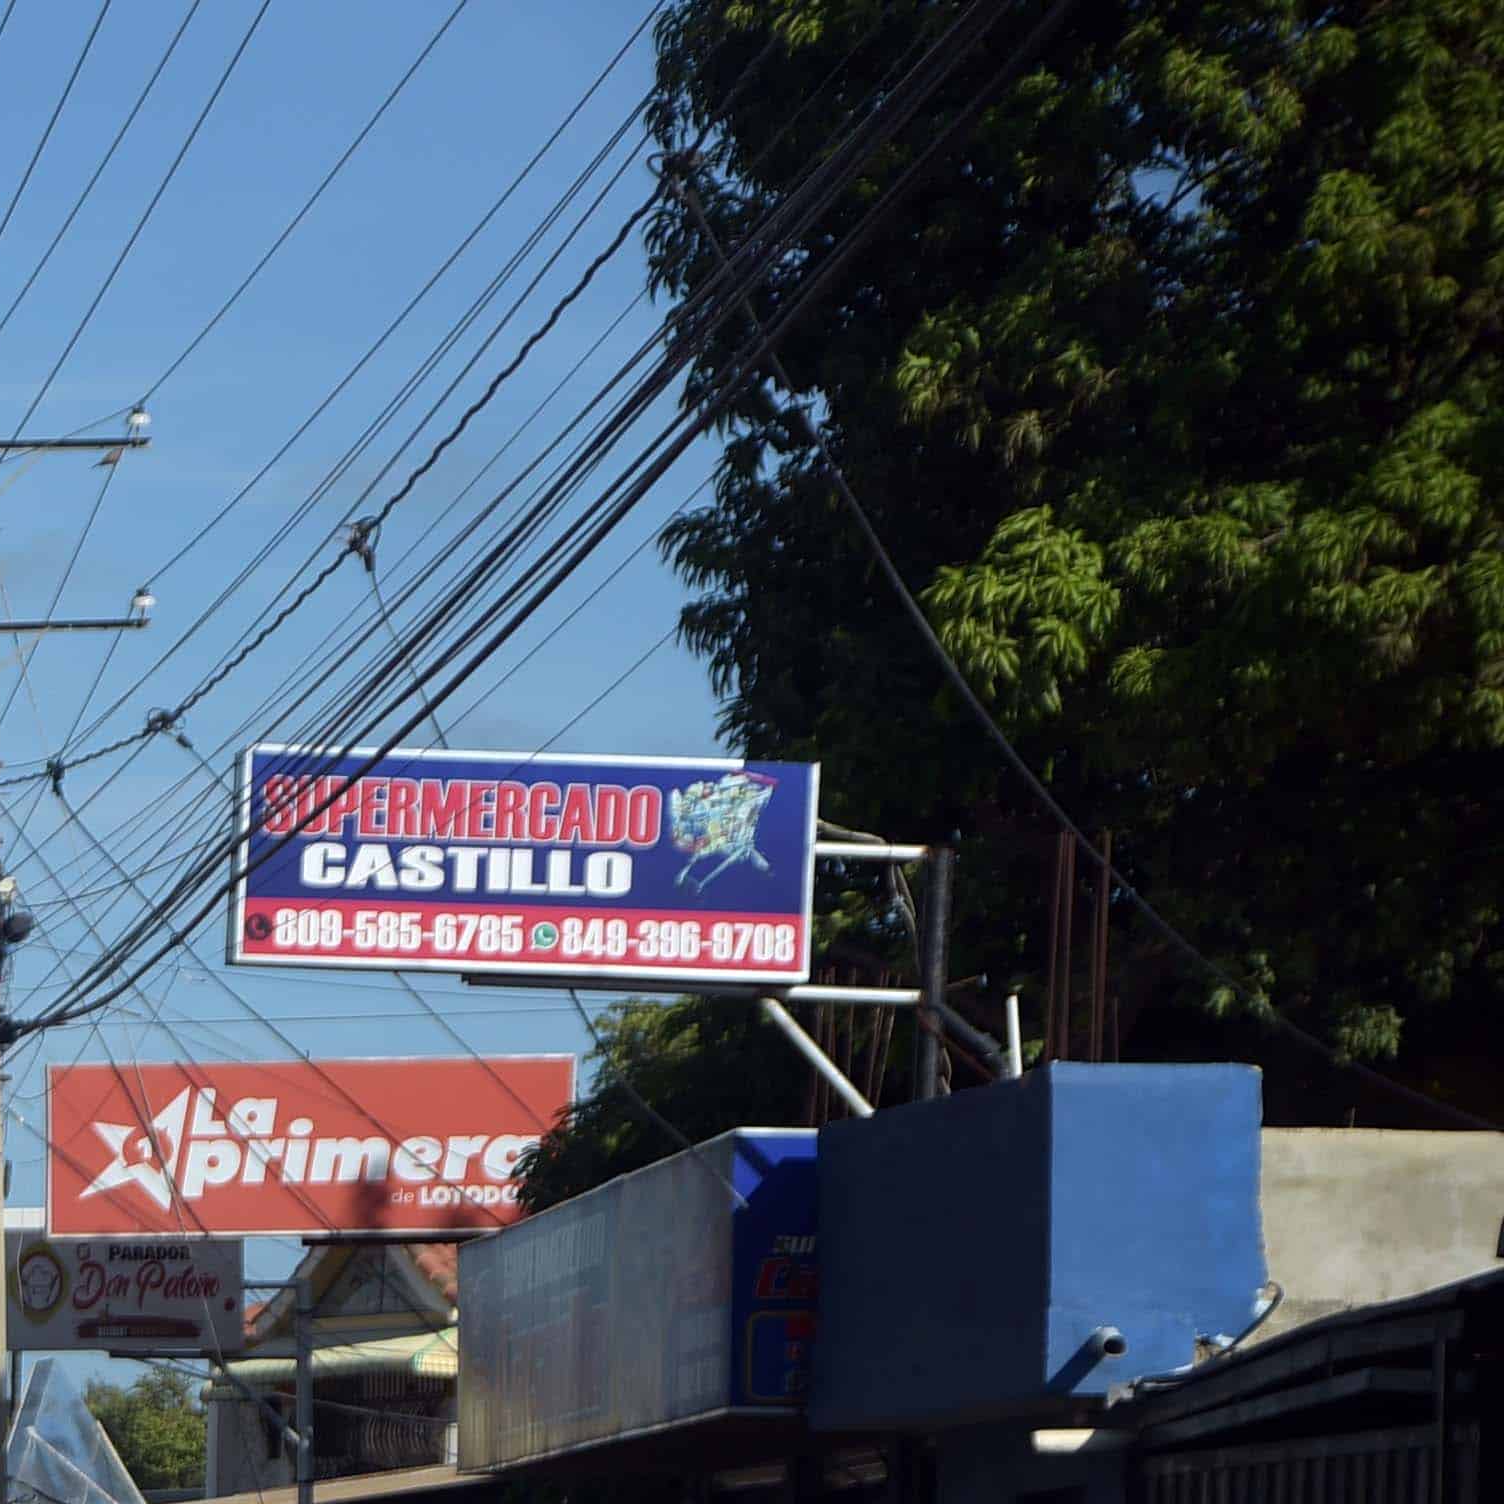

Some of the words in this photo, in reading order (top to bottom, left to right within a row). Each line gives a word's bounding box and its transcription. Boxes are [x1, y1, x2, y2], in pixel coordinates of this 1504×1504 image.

[263, 774, 662, 845] SUPERMERCADO
[300, 842, 633, 897] CASTILLO
[274, 908, 524, 954] 809-585-6785
[562, 917, 795, 962] 849-396-9708
[190, 1086, 278, 1136] La
[182, 1118, 542, 1199] primera
[392, 1186, 415, 1202] de
[109, 1245, 191, 1261] PARADOR
[73, 1261, 129, 1309] Don
